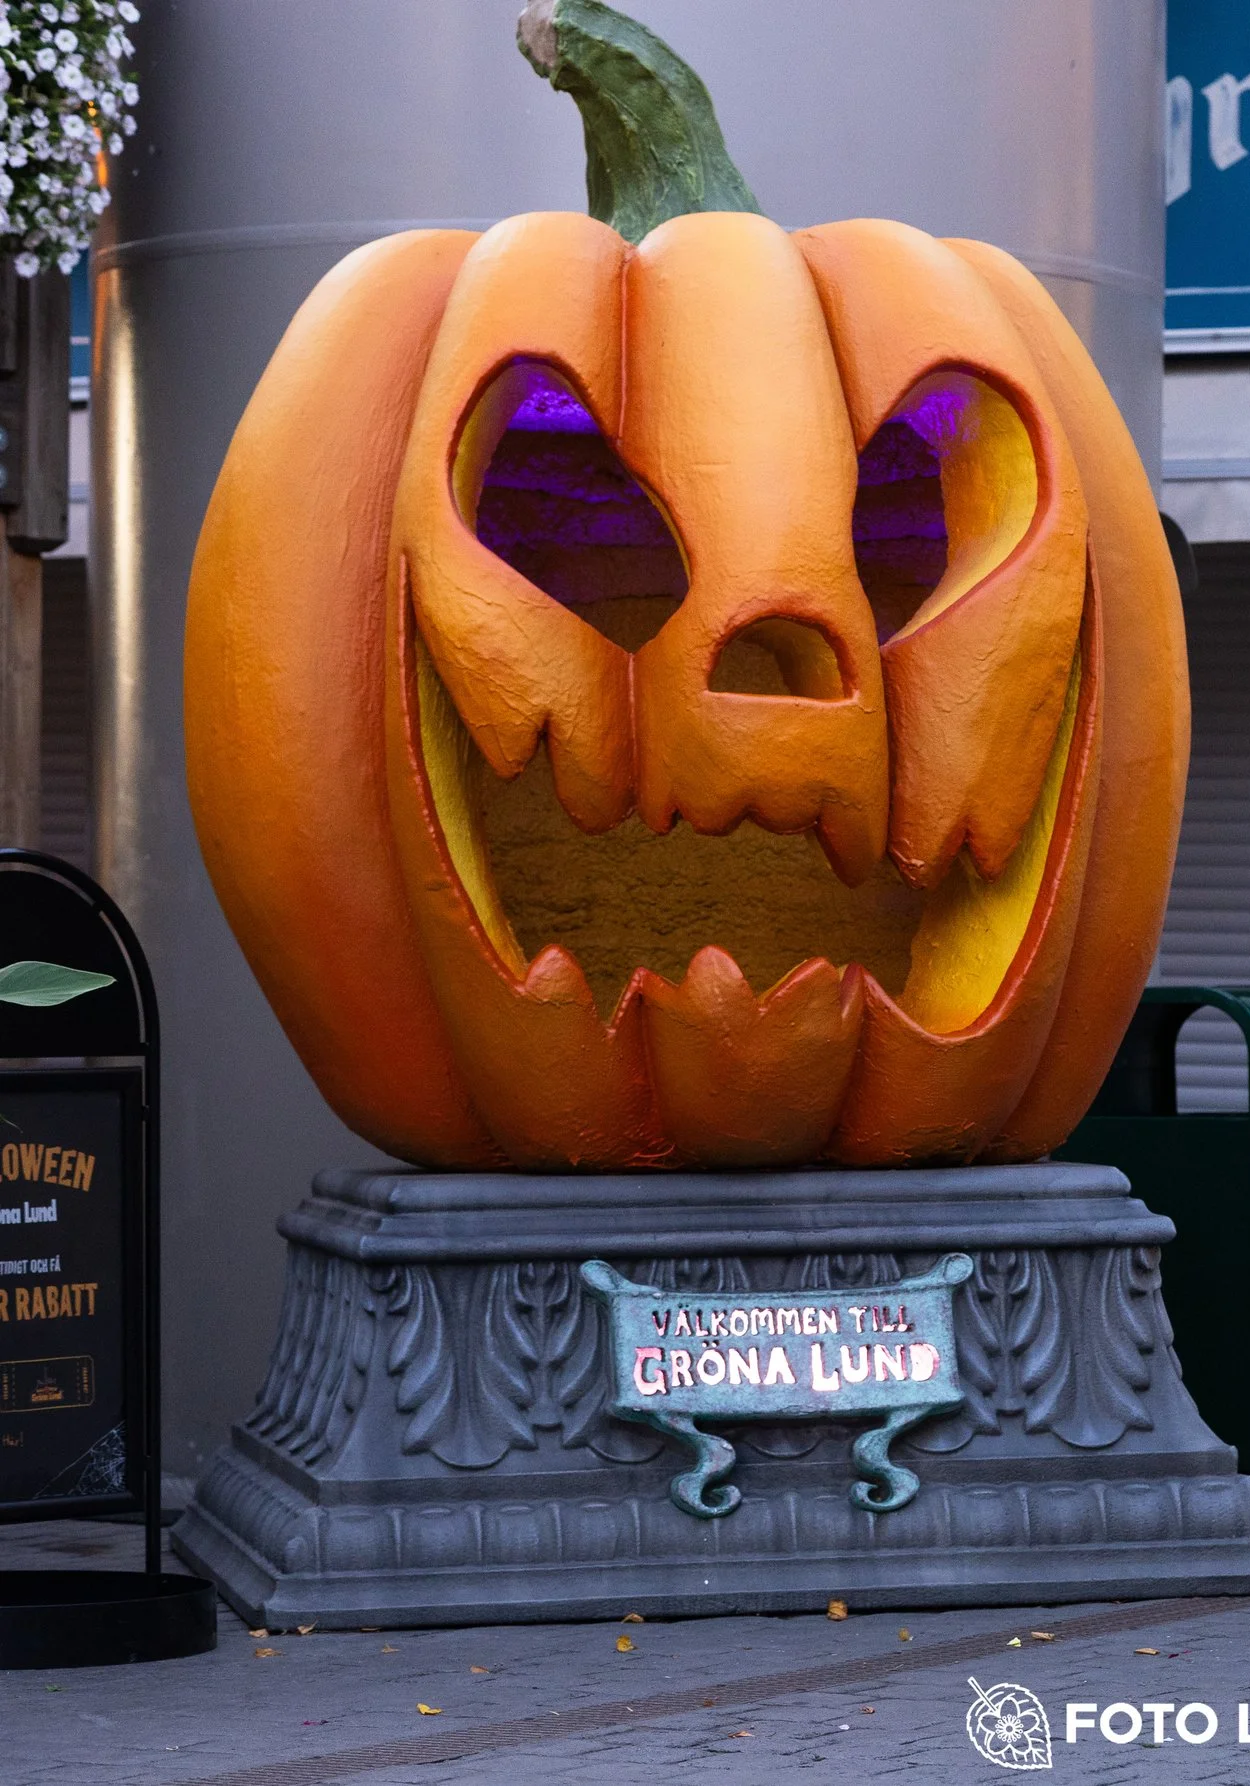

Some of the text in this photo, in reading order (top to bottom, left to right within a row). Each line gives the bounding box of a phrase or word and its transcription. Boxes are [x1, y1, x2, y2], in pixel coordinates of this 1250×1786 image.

[0, 1143, 95, 1192] OWEEN
[24, 1199, 57, 1223] Lund
[31, 1258, 48, 1273] OCH
[50, 1254, 61, 1272] FÅ
[16, 1283, 98, 1320] RABATT
[652, 1303, 914, 1337] VÄLKOMMEN TILL
[633, 1341, 939, 1396] GRÖNA LUND
